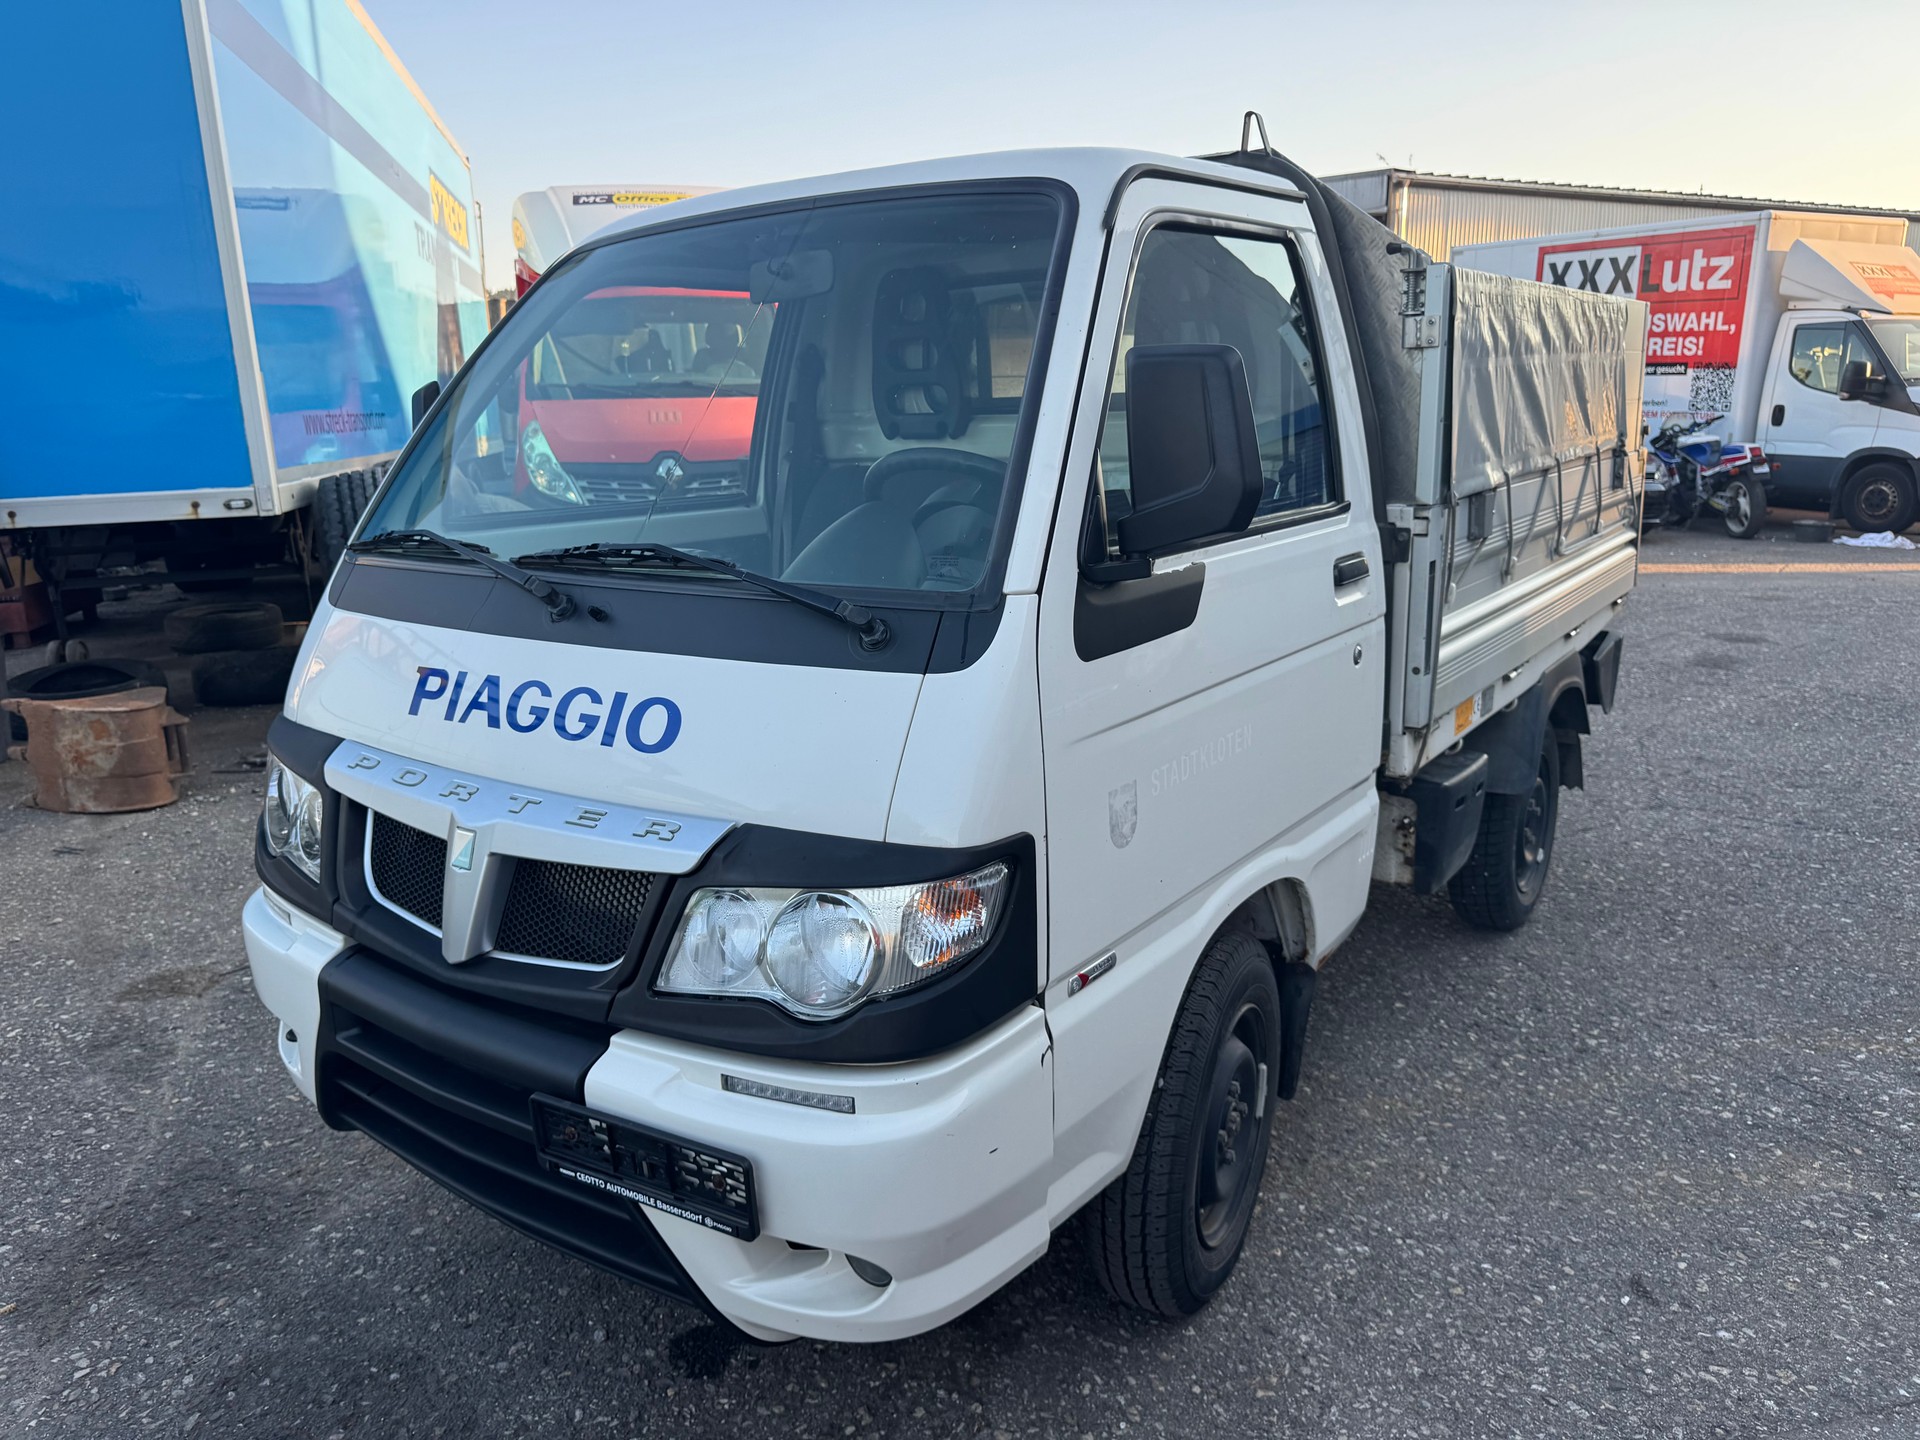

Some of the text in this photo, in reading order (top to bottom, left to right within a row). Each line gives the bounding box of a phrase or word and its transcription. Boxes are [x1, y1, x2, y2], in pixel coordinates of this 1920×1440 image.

[579, 196, 608, 204] MC
[1548, 248, 1735, 294] XXXLutz
[1648, 311, 1736, 335] SWAHL,
[1647, 336, 1705, 357] REIS!
[408, 666, 682, 754] PIAGGIO
[347, 751, 683, 842] PORTER
[576, 1172, 605, 1188] CEOTTO
[606, 1182, 656, 1207] AUTOMOBILE
[656, 1200, 702, 1223] Bassersdorf
